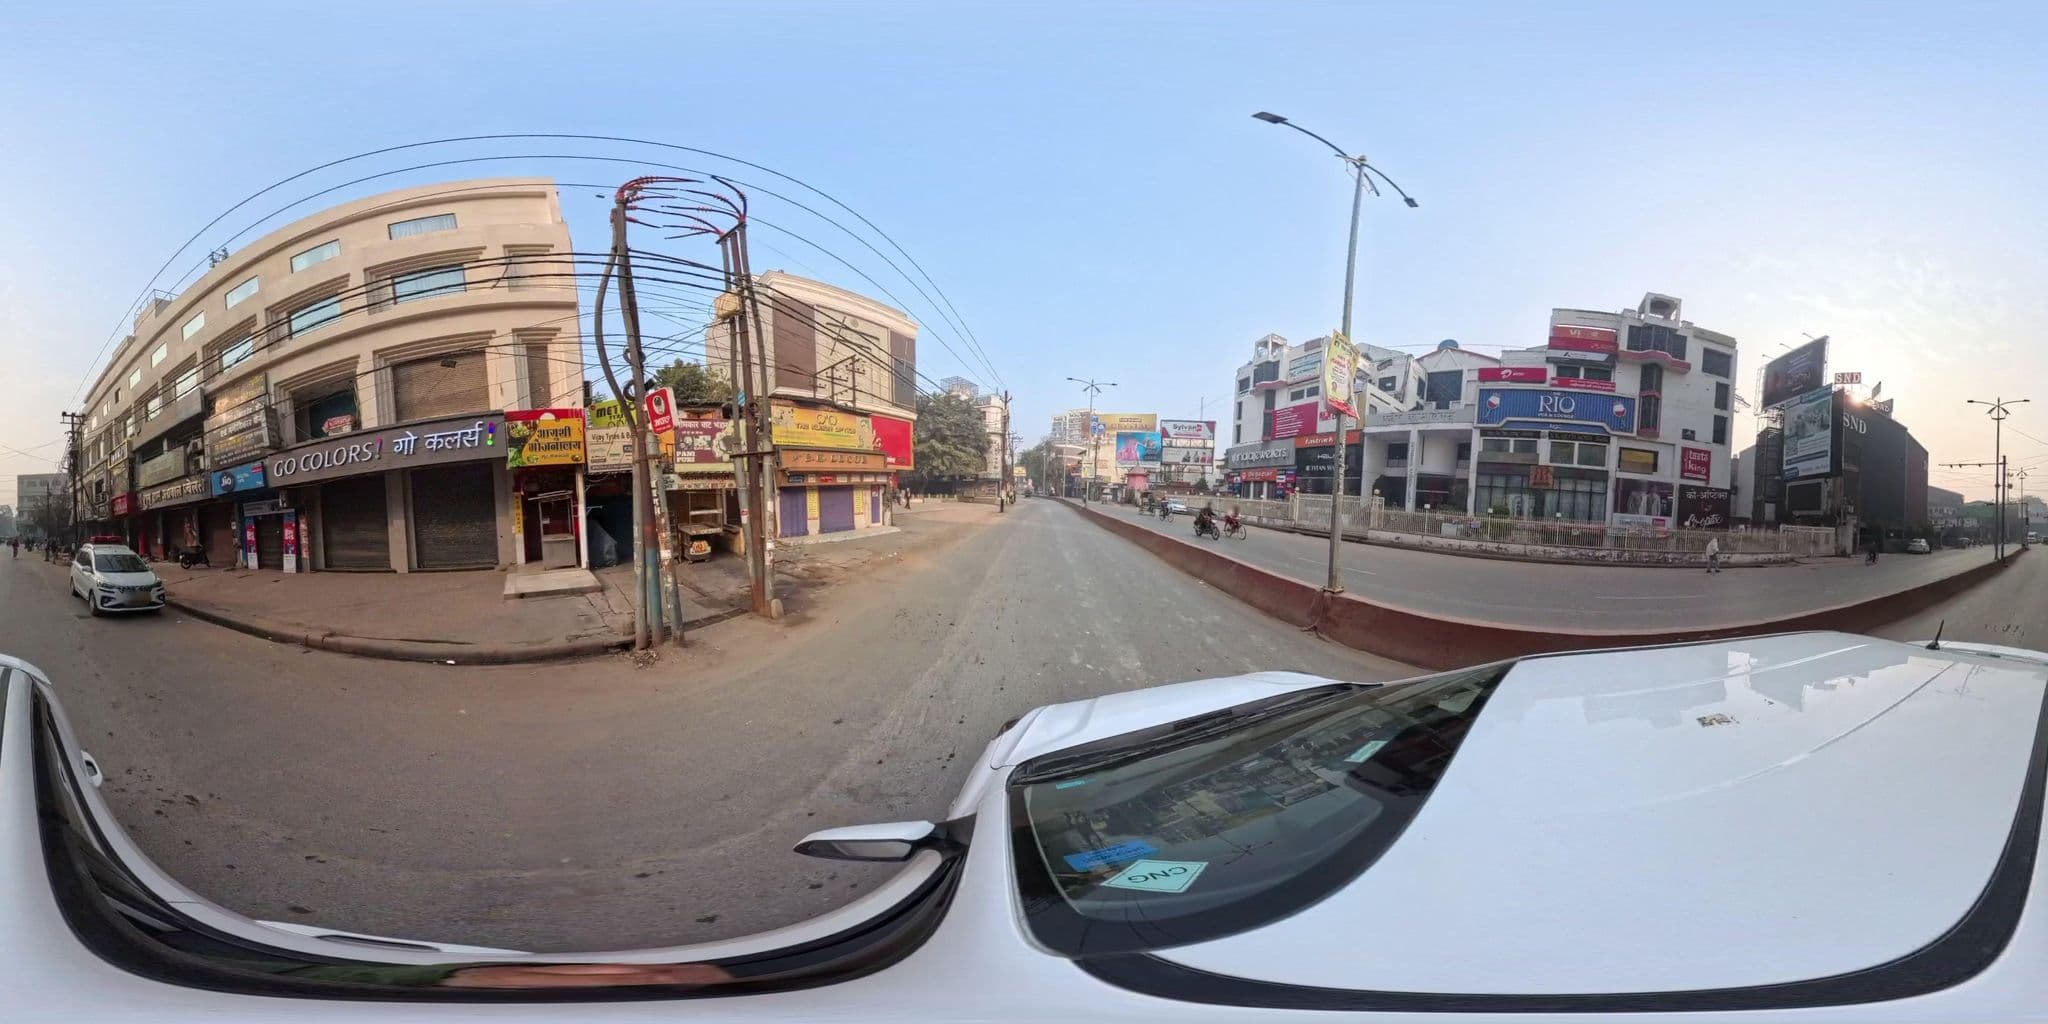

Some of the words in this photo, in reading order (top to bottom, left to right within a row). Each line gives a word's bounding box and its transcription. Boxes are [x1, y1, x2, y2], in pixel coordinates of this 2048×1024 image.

[1835, 372, 1861, 384] SND
[1538, 395, 1576, 414] RIO
[1843, 412, 1867, 434] SND
[393, 431, 418, 456] गो
[273, 457, 297, 478] GO
[300, 438, 384, 472] COLORS!
[1128, 866, 1188, 884] CNG
